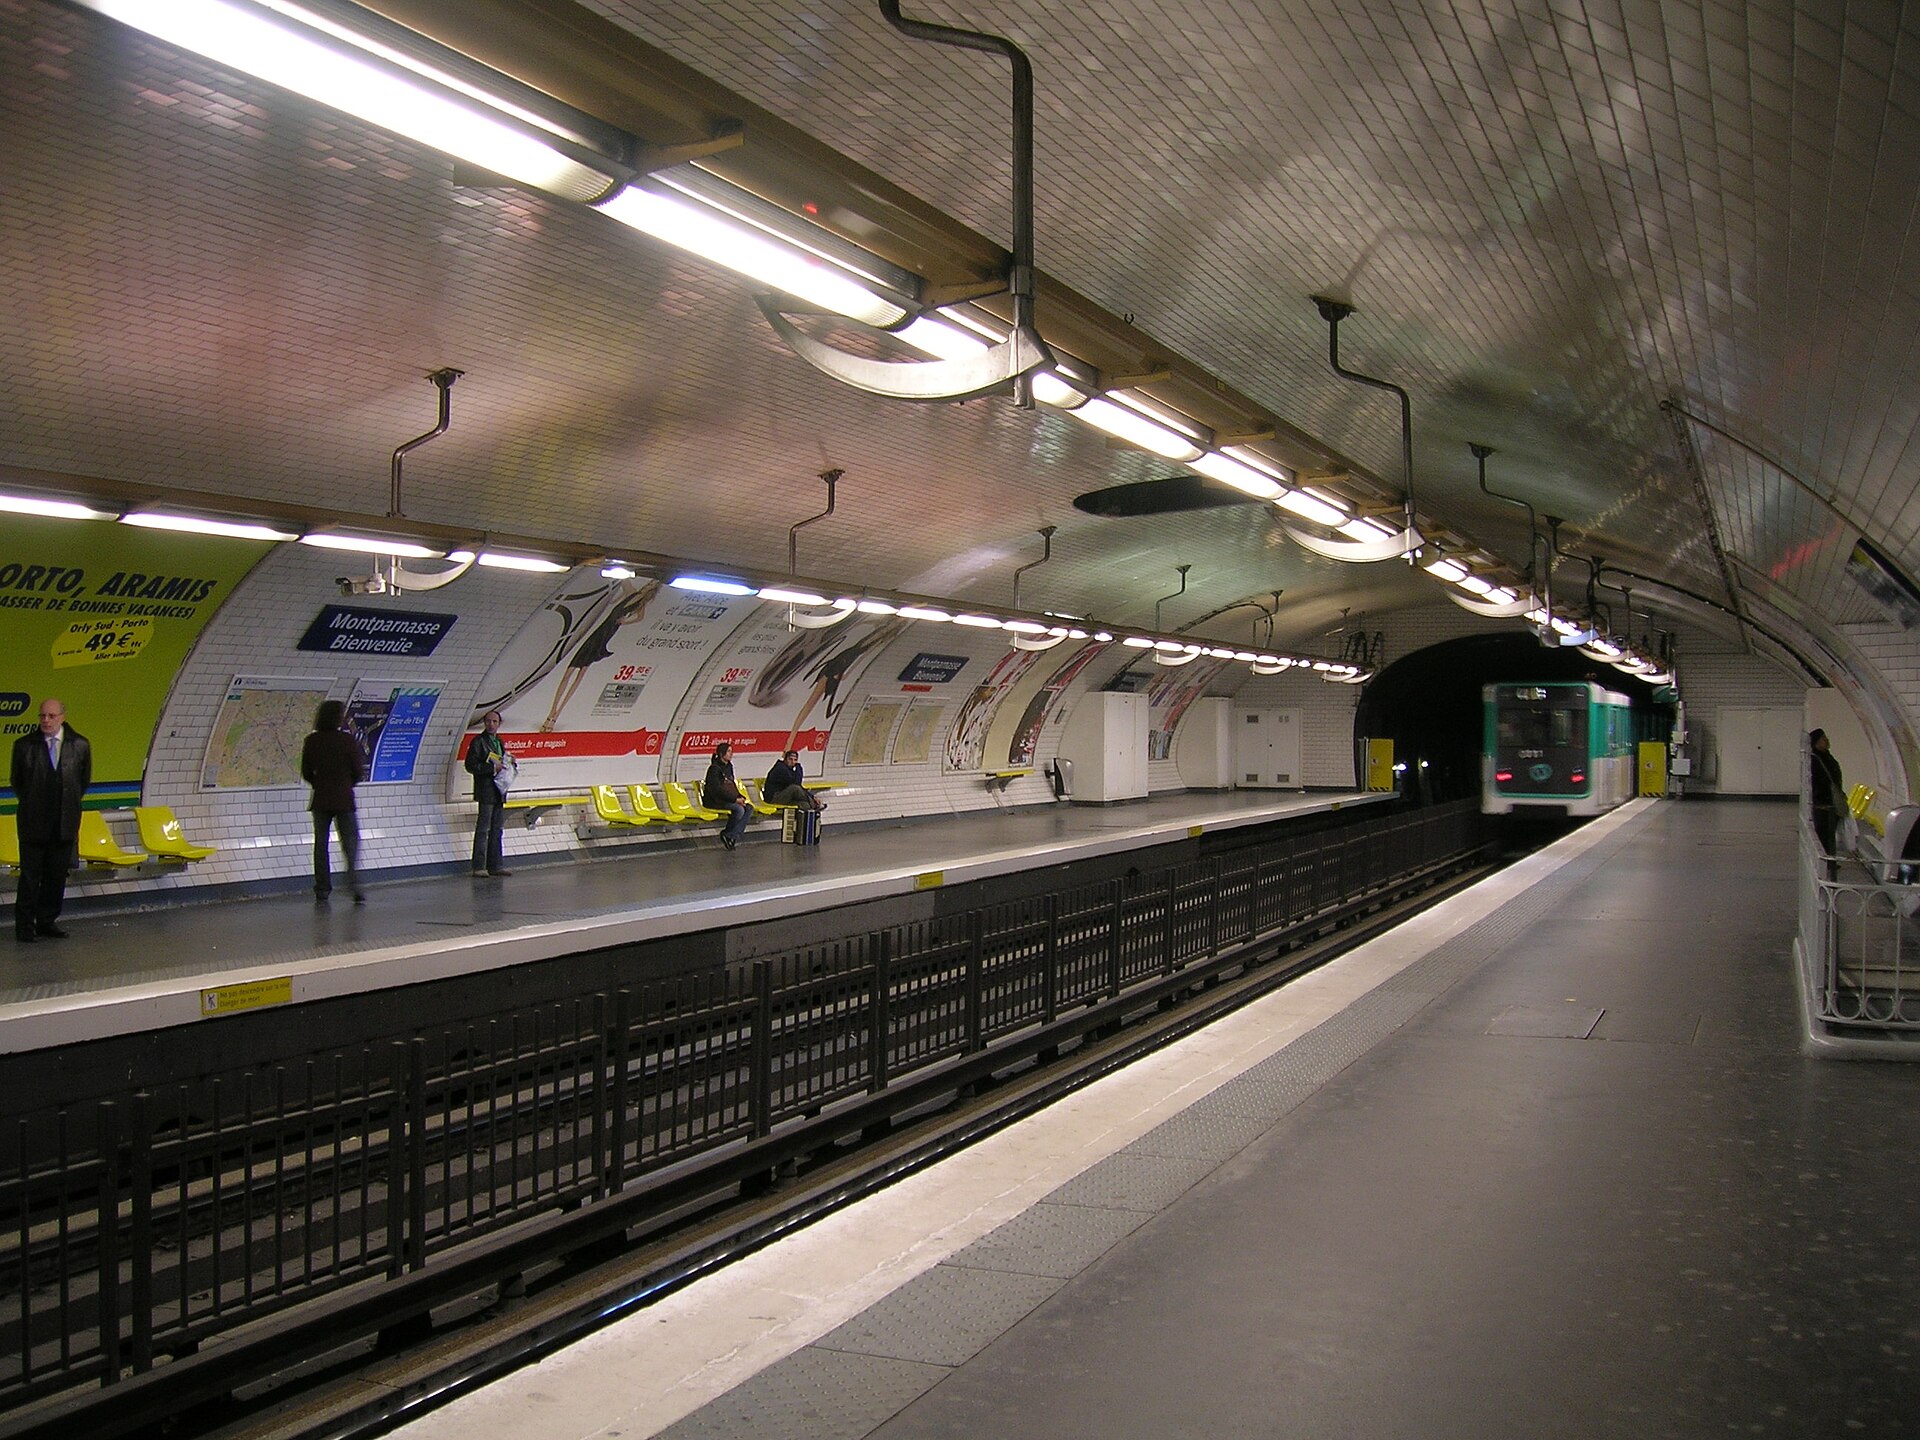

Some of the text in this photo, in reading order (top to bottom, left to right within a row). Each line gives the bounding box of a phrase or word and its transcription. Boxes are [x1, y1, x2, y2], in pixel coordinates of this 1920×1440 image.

[96, 571, 218, 603] ARAMIS
[46, 598, 66, 611] DE
[68, 600, 126, 615] BONNES
[126, 604, 196, 620] VACANCES)
[70, 623, 92, 633] Orly
[94, 620, 115, 631] Sud
[121, 619, 149, 628] Porto
[329, 613, 441, 635] Montparnasse
[85, 632, 116, 651] 49
[116, 632, 134, 648] €
[330, 634, 413, 653] Bienvenüe
[113, 650, 136, 659] simple
[0, 700, 23, 711] om
